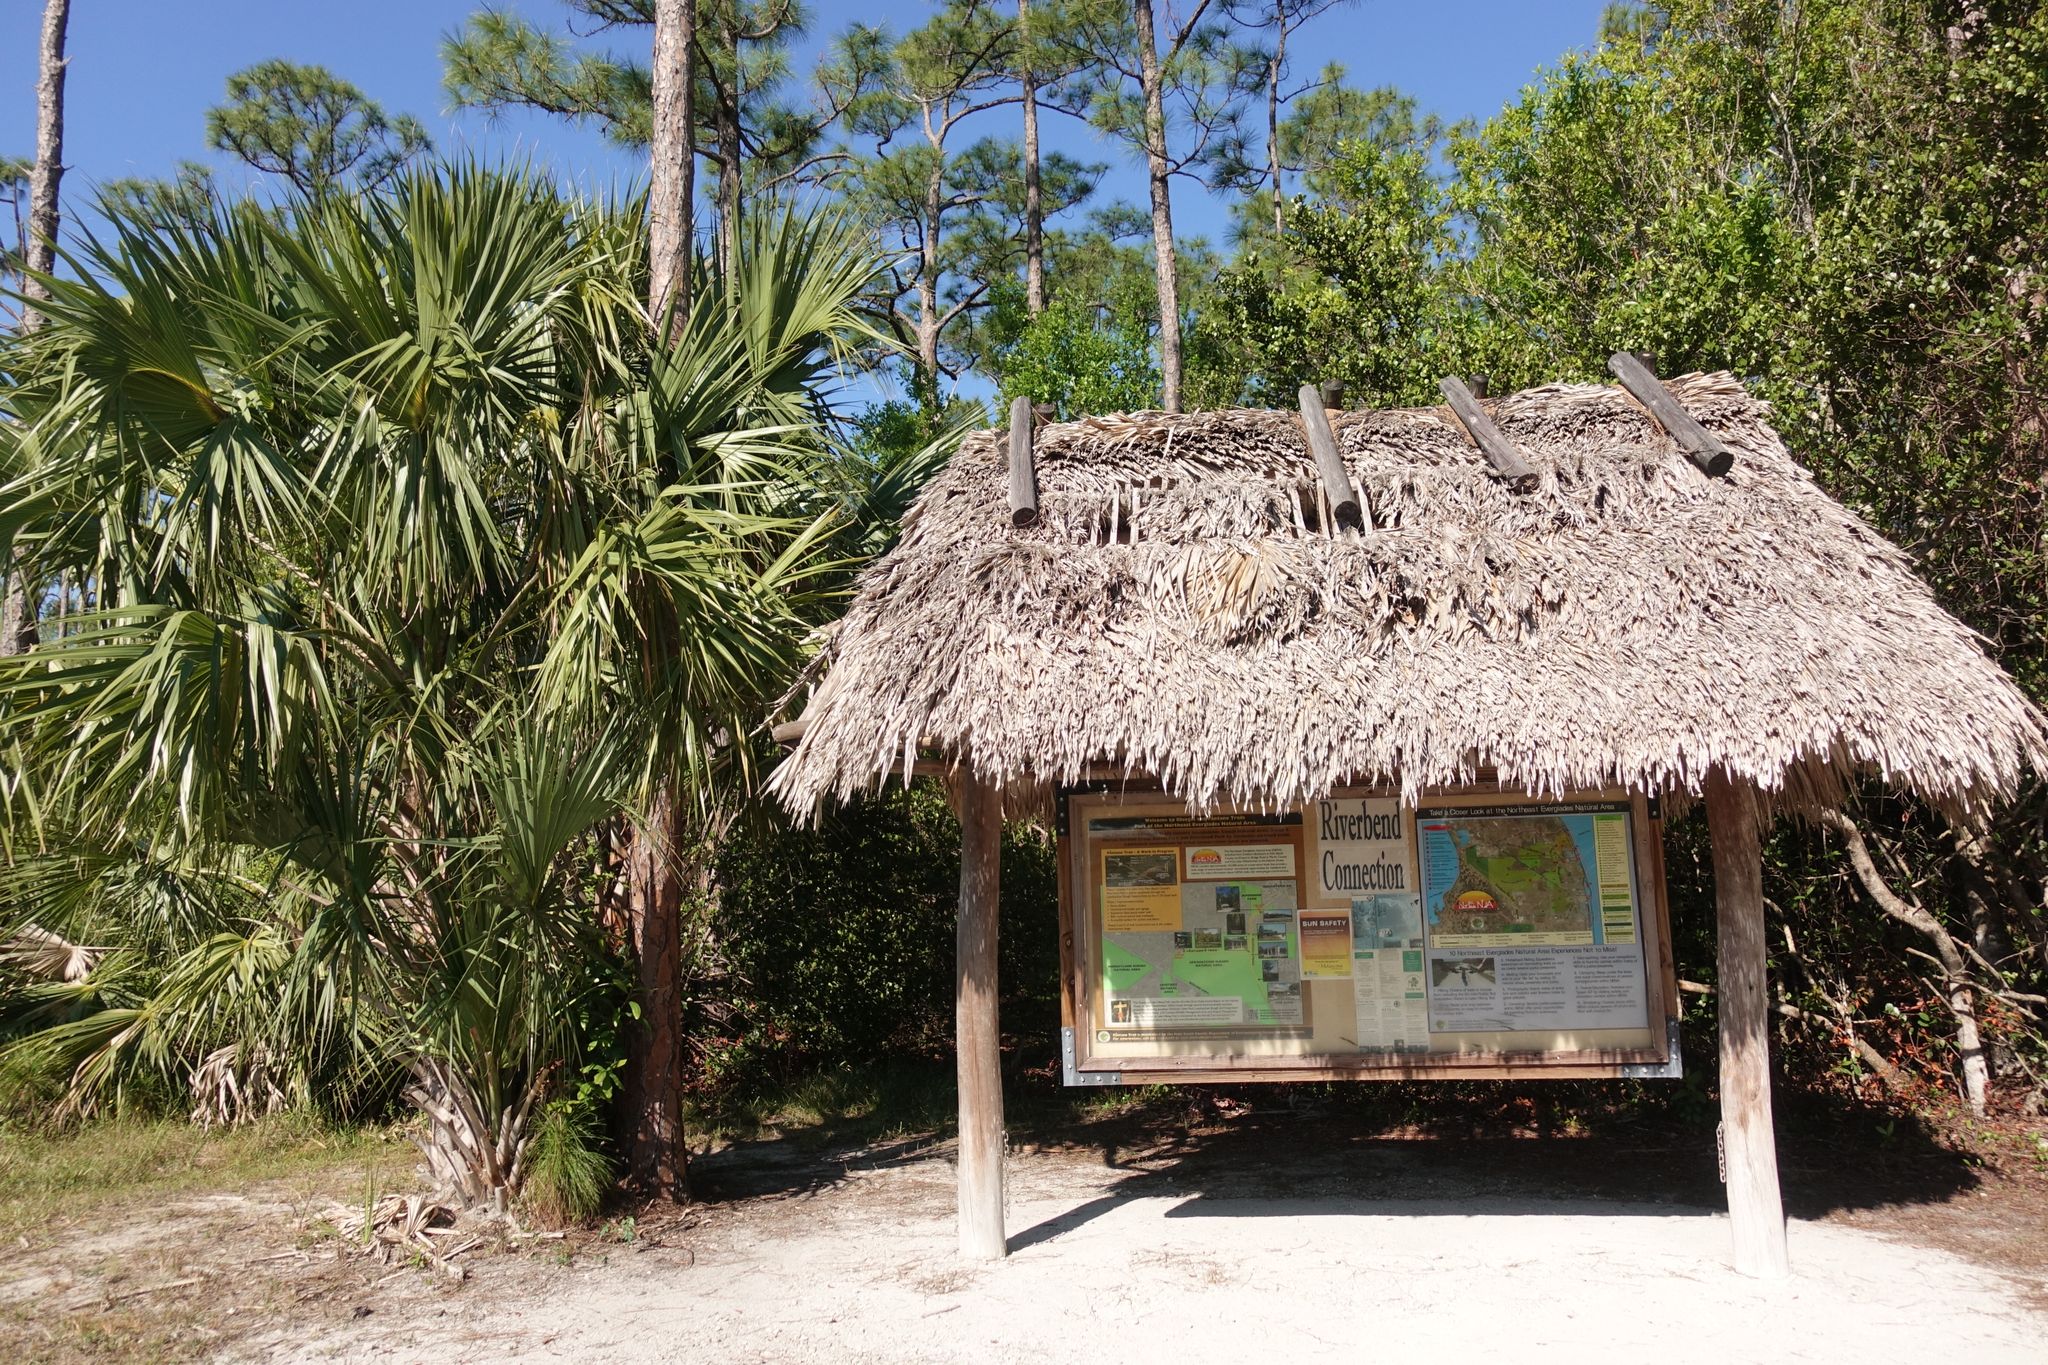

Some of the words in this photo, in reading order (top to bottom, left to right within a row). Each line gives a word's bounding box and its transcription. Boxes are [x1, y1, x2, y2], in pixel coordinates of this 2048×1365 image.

[1449, 808, 1468, 816] Closer
[1486, 807, 1493, 815] at
[1540, 805, 1574, 813] Everglades
[1320, 800, 1402, 840] Riverbend
[1322, 850, 1405, 890] Connection
[1319, 919, 1347, 927] SAFETY
[1551, 947, 1582, 955] Experiences
[1583, 946, 1593, 954] Not
